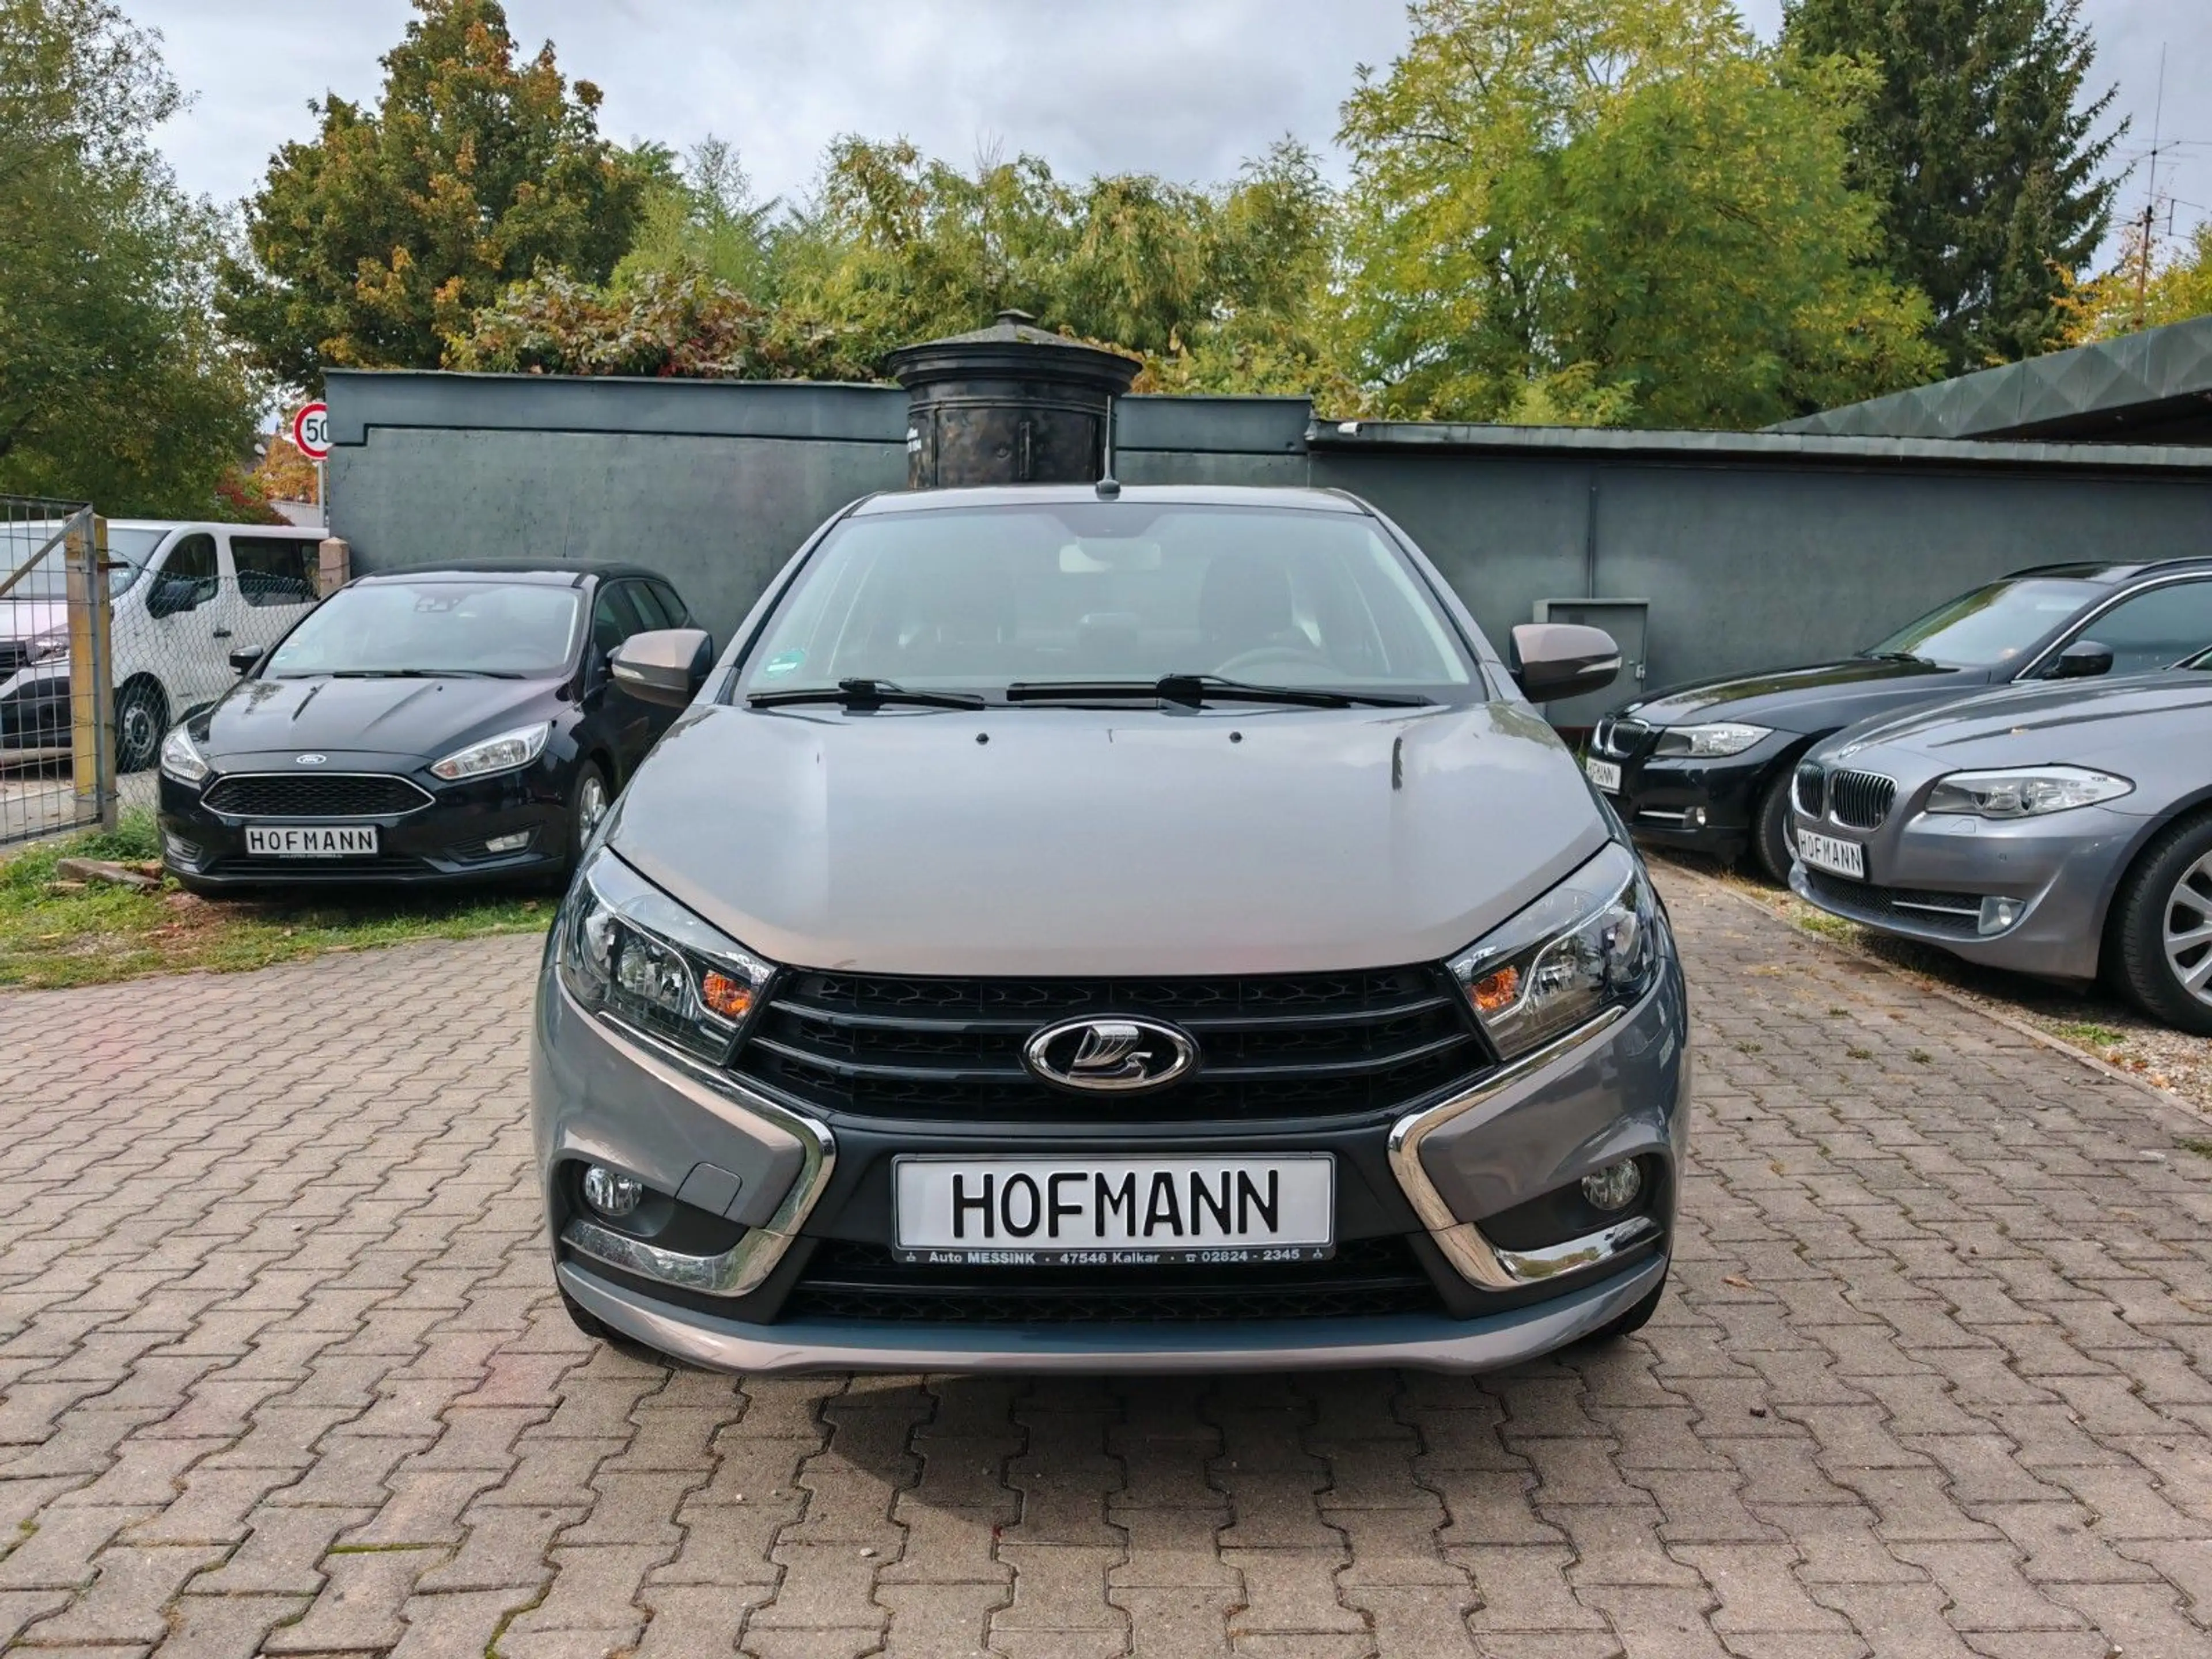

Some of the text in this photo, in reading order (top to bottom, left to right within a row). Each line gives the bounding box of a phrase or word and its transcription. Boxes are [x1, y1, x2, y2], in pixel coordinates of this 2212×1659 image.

[306, 419, 328, 442] 50
[249, 831, 373, 850] HOFMANN
[1800, 833, 1861, 872] HOFMANN
[952, 1170, 1278, 1238] HOFMANN
[929, 1252, 963, 1263] Auto
[968, 1252, 1036, 1264] MESSINK
[1060, 1252, 1107, 1263] 47546
[1112, 1252, 1160, 1263] Kalkar
[1202, 1251, 1248, 1262] 02824
[1263, 1249, 1300, 1260] 2345
